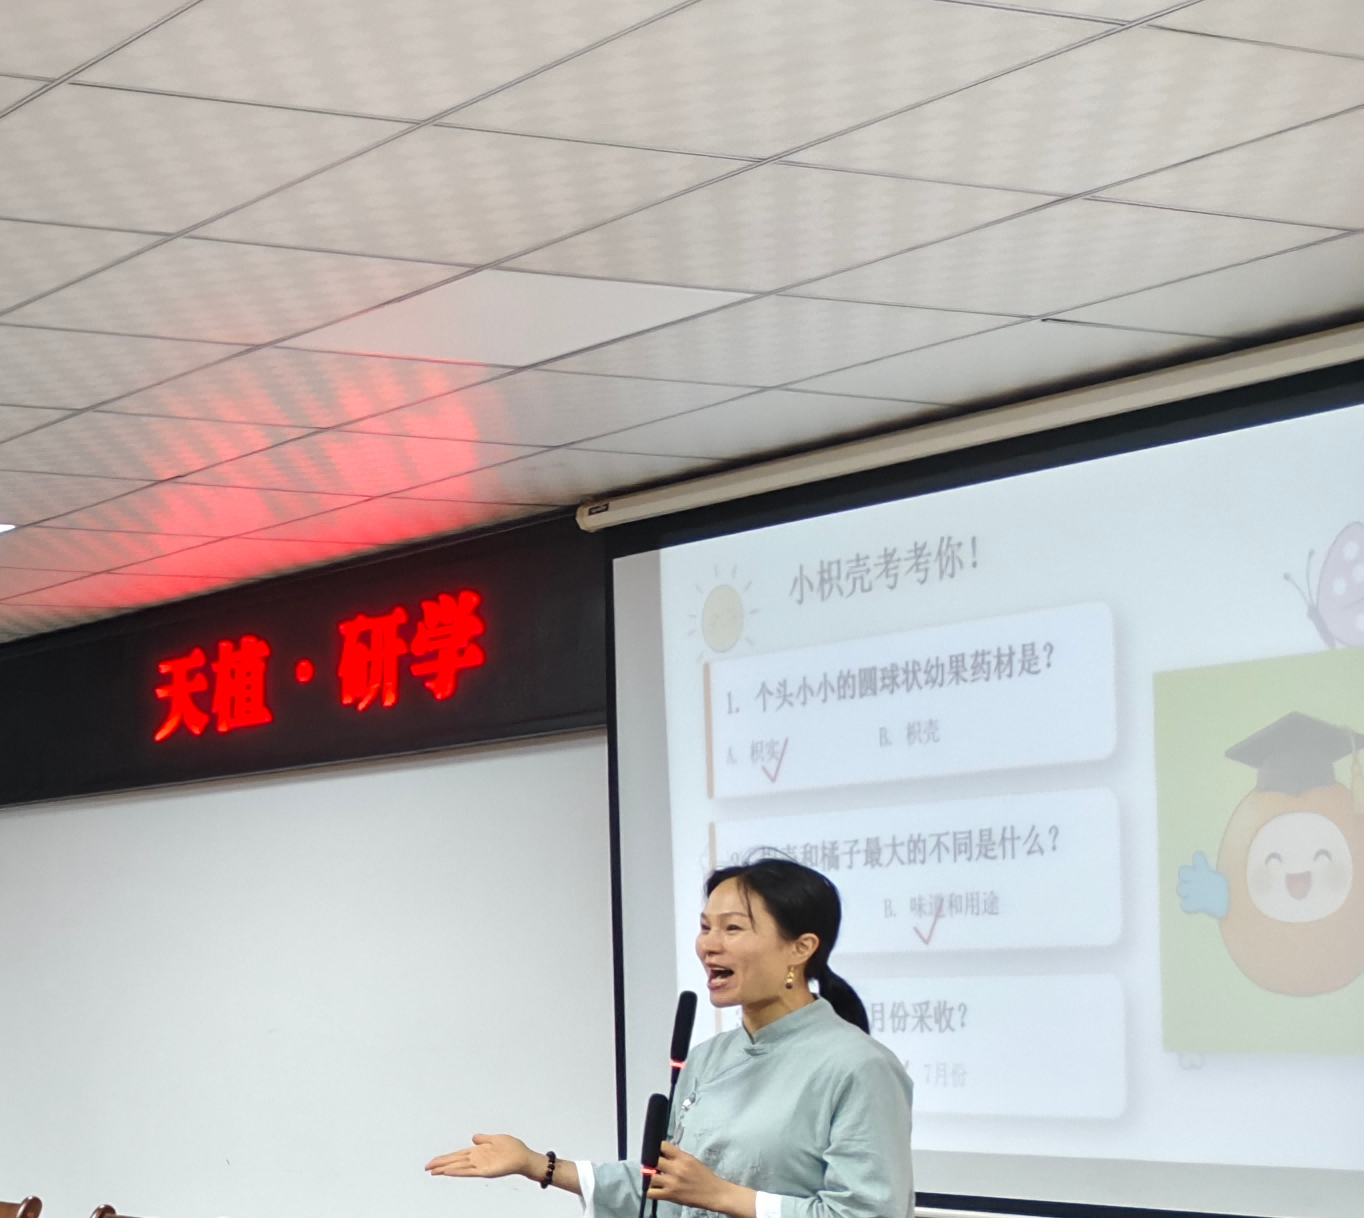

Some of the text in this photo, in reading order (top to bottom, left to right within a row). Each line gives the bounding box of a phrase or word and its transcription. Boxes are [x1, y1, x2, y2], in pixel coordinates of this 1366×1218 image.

[761, 824, 1061, 871] 和橘子最大的不同是什么？
